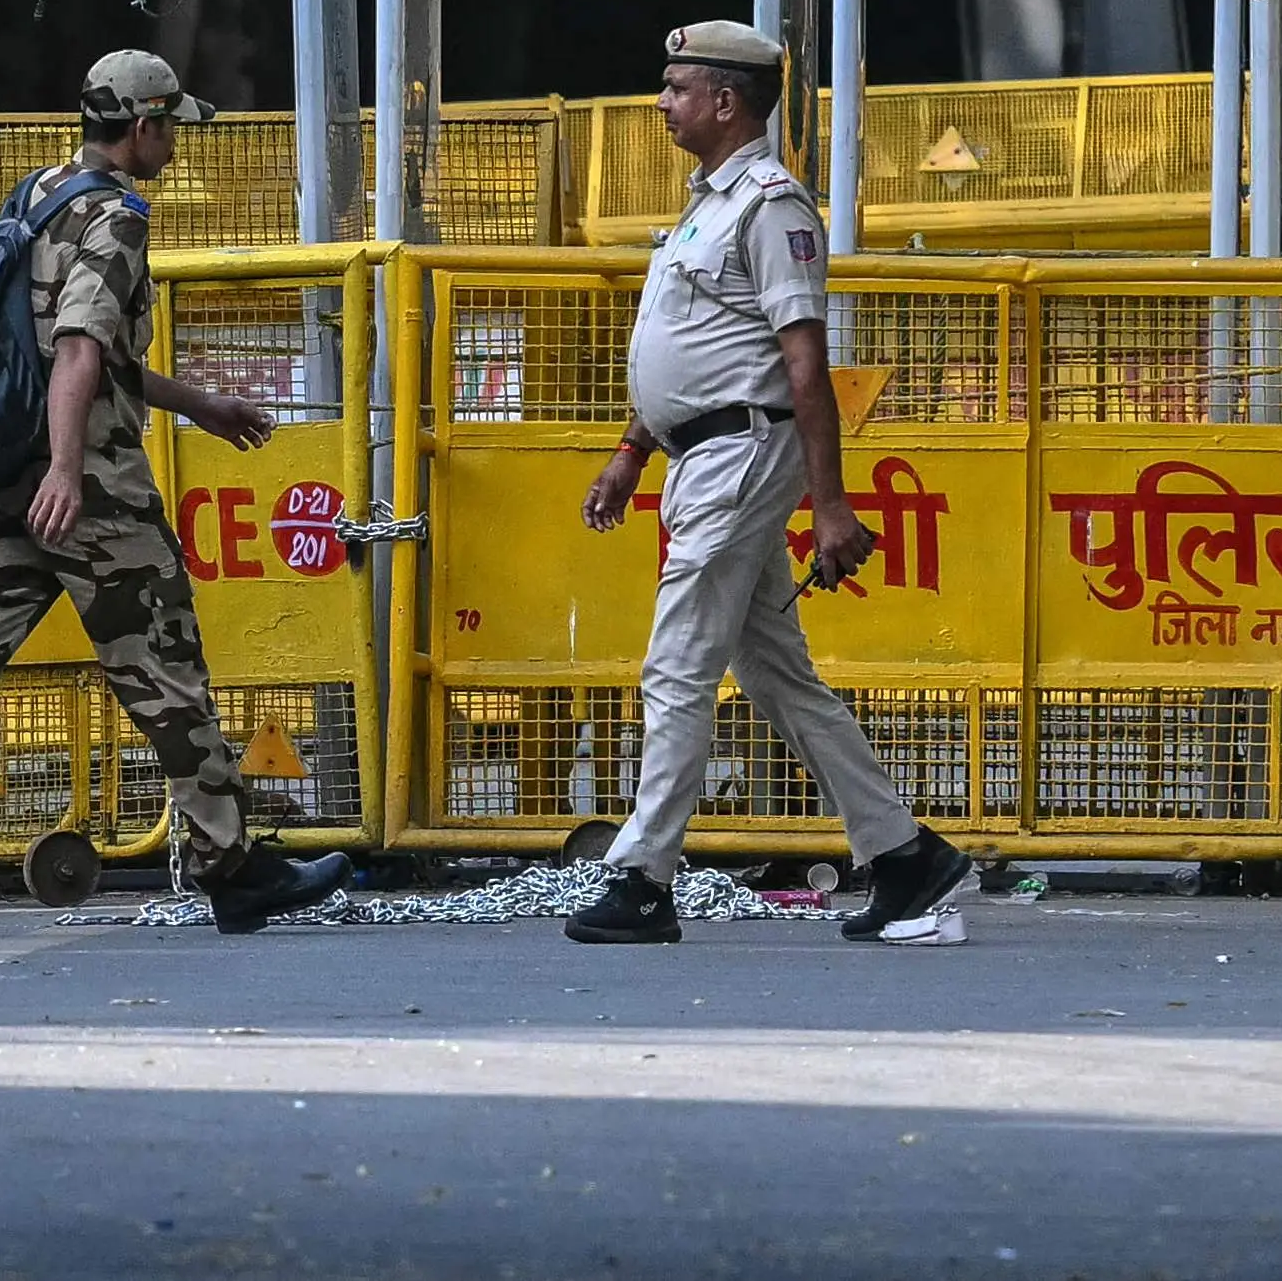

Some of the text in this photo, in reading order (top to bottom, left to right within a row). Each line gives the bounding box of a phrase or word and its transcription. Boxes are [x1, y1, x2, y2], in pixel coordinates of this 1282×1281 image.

[288, 486, 330, 515] D-21
[288, 531, 327, 567] 201
[455, 608, 481, 632] 70
[1147, 590, 1241, 647] जिला
